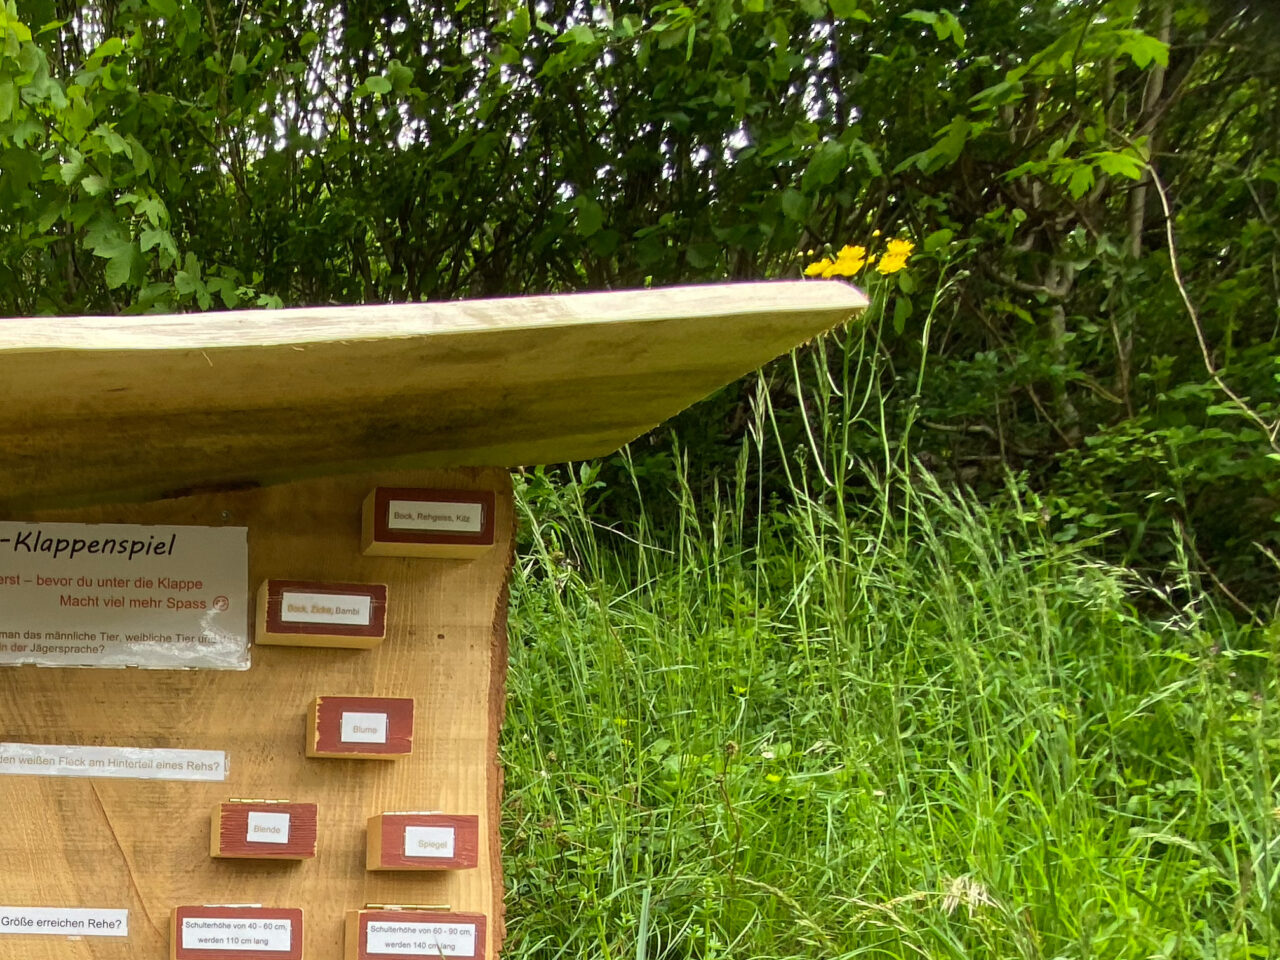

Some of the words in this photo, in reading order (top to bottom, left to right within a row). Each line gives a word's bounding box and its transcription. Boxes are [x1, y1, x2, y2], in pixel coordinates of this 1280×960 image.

[393, 511, 415, 521] Bock,
[36, 575, 72, 587] bevor
[77, 575, 93, 588] du
[97, 577, 129, 589] unter
[133, 577, 153, 589] die
[157, 578, 203, 594] Klappe
[60, 595, 99, 607] Macht
[103, 595, 125, 608] viel
[129, 596, 162, 609] mehr
[166, 597, 206, 611] Spass
[335, 606, 360, 617] Bambi
[23, 629, 42, 640] das
[45, 630, 96, 641] männliche
[125, 632, 172, 643] weibliche
[176, 633, 195, 644] Tier
[0, 642, 8, 652] in
[10, 642, 28, 653] der
[30, 643, 106, 655] Jägersprache?
[353, 725, 378, 735] Blume
[18, 755, 55, 766] weißen
[58, 756, 86, 767] Fleck
[88, 758, 105, 768] am
[108, 758, 153, 769] Hinterteil
[155, 760, 184, 770] eines
[186, 760, 220, 772] Rehs?
[253, 824, 281, 834] Blende
[418, 839, 448, 850] Spiegel
[1, 916, 34, 927] Größe
[36, 917, 84, 928] erreichen
[88, 919, 122, 929] Rehe?
[185, 921, 232, 930] Schulterhöhe
[247, 922, 258, 930] 40
[263, 923, 272, 931] 60
[274, 924, 287, 932] cm,
[370, 925, 417, 935] Schulterhöhe
[418, 927, 432, 935] von
[433, 927, 442, 935] 60
[198, 936, 224, 945] werden
[226, 936, 239, 945] 110
[254, 937, 269, 947] lang
[385, 941, 411, 949] werden
[413, 941, 426, 949] 140
[440, 942, 456, 952] lang
